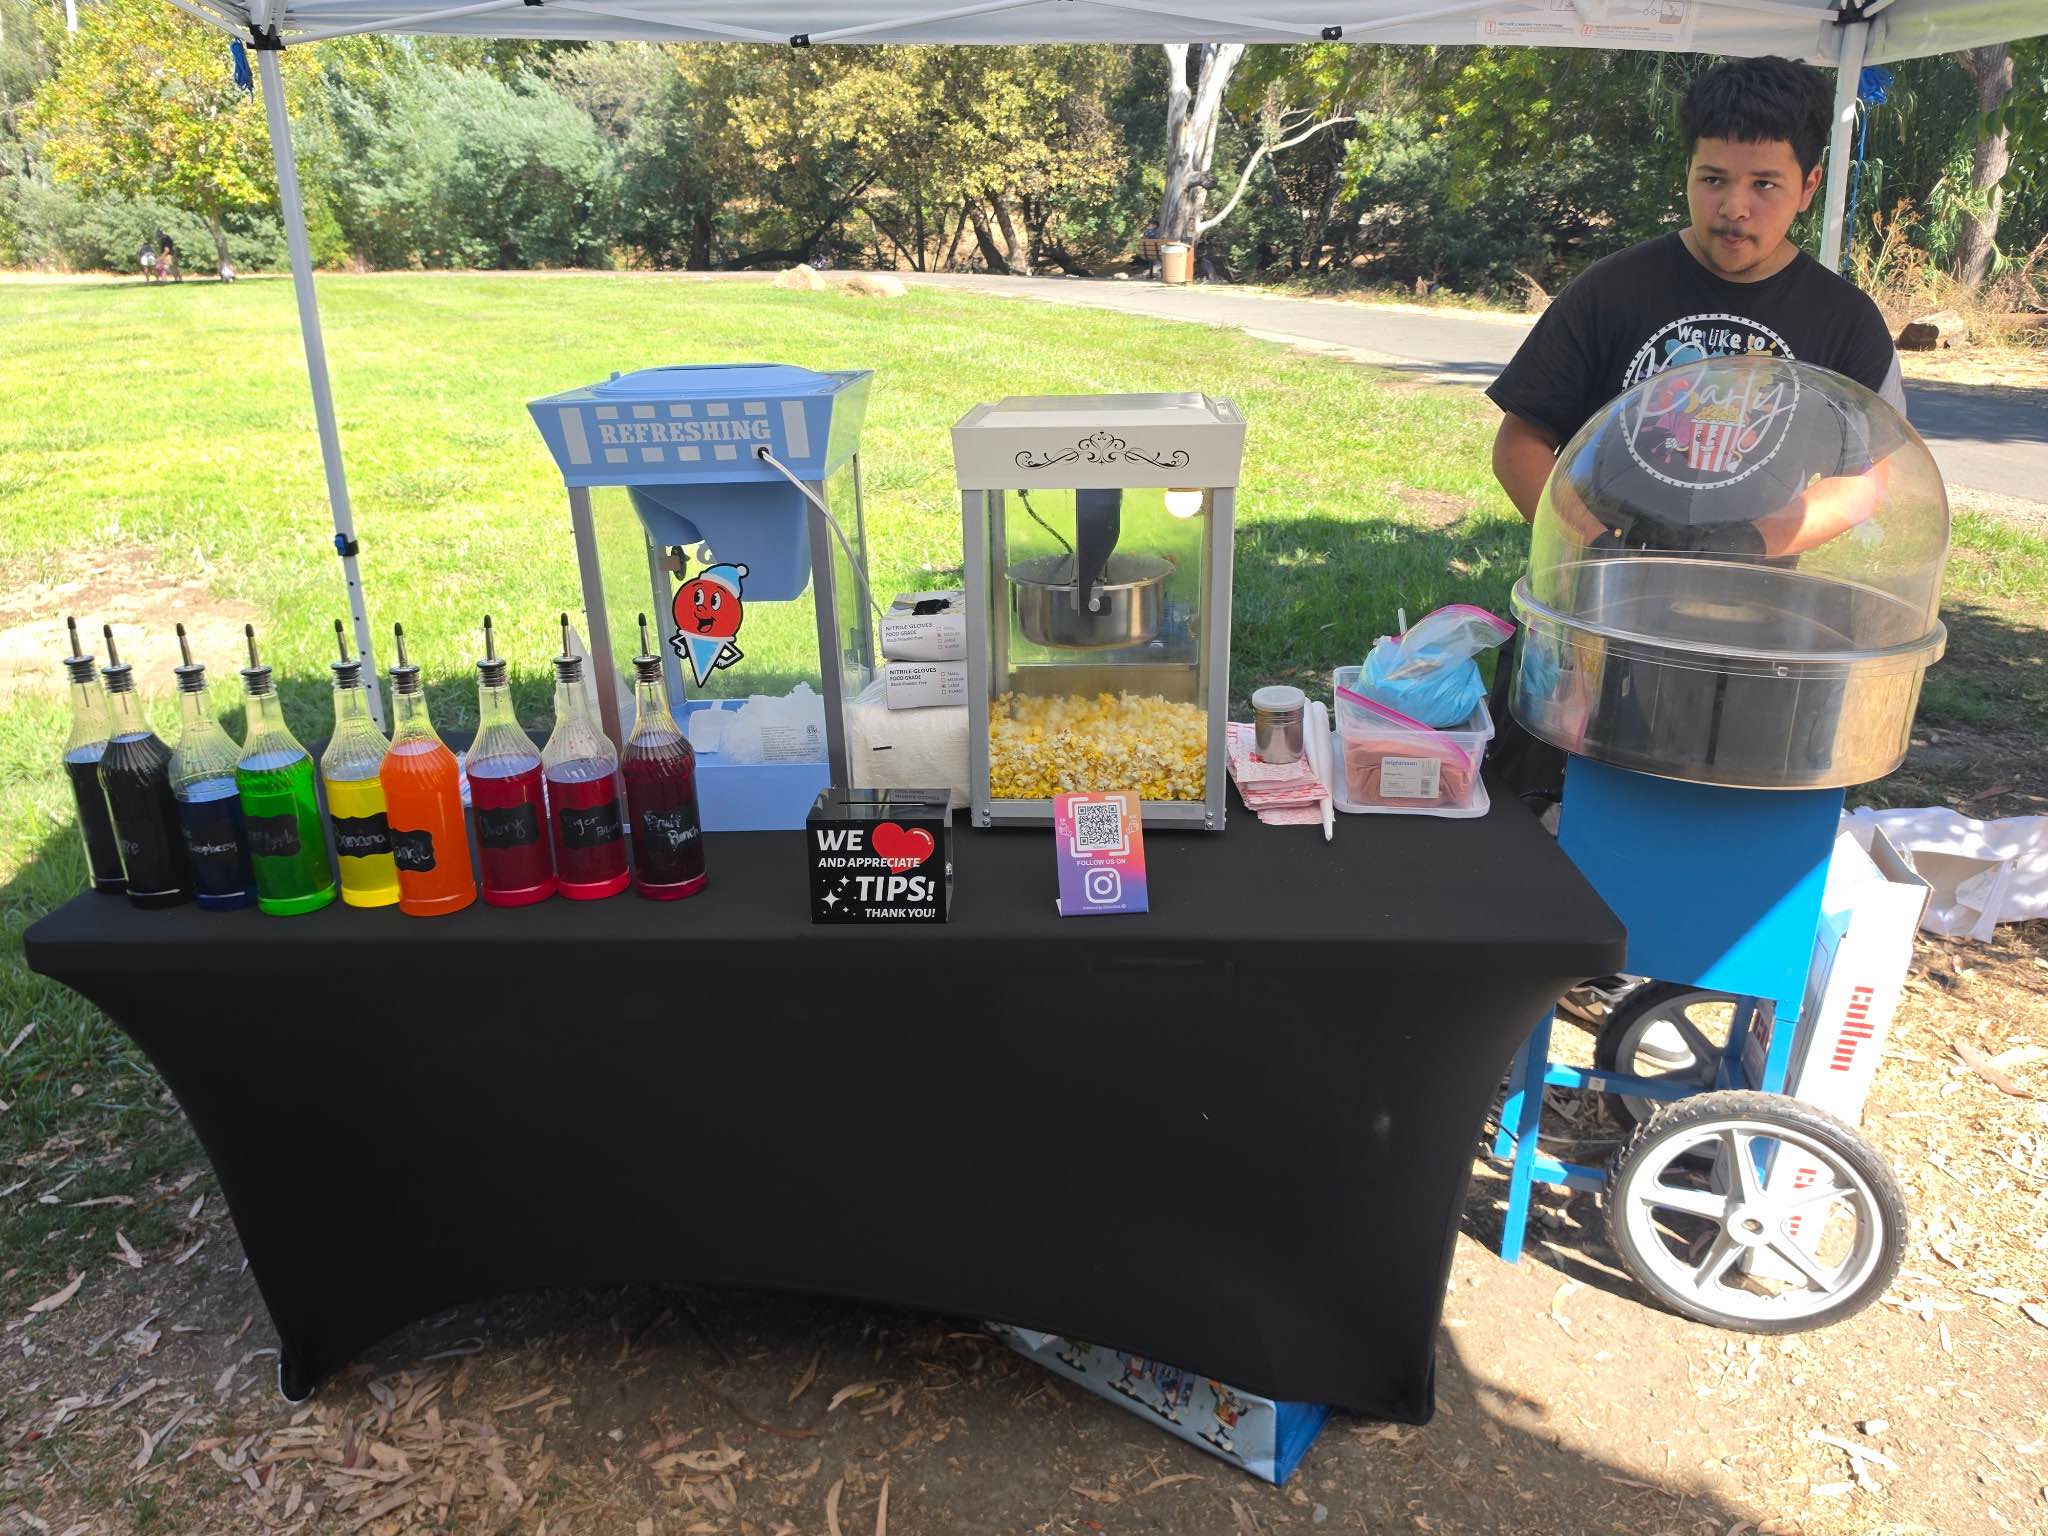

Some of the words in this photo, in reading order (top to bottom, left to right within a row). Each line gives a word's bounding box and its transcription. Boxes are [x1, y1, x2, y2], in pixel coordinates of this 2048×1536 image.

[1678, 324, 1702, 342] We
[1747, 333, 1766, 351] to
[598, 419, 771, 444] REFRESHING
[816, 829, 864, 851] WE
[818, 857, 847, 868] AND
[847, 857, 921, 868] APPRECIATE
[855, 876, 936, 902] TIPS!
[865, 908, 906, 918] THANK
[907, 908, 936, 918] YOU!
